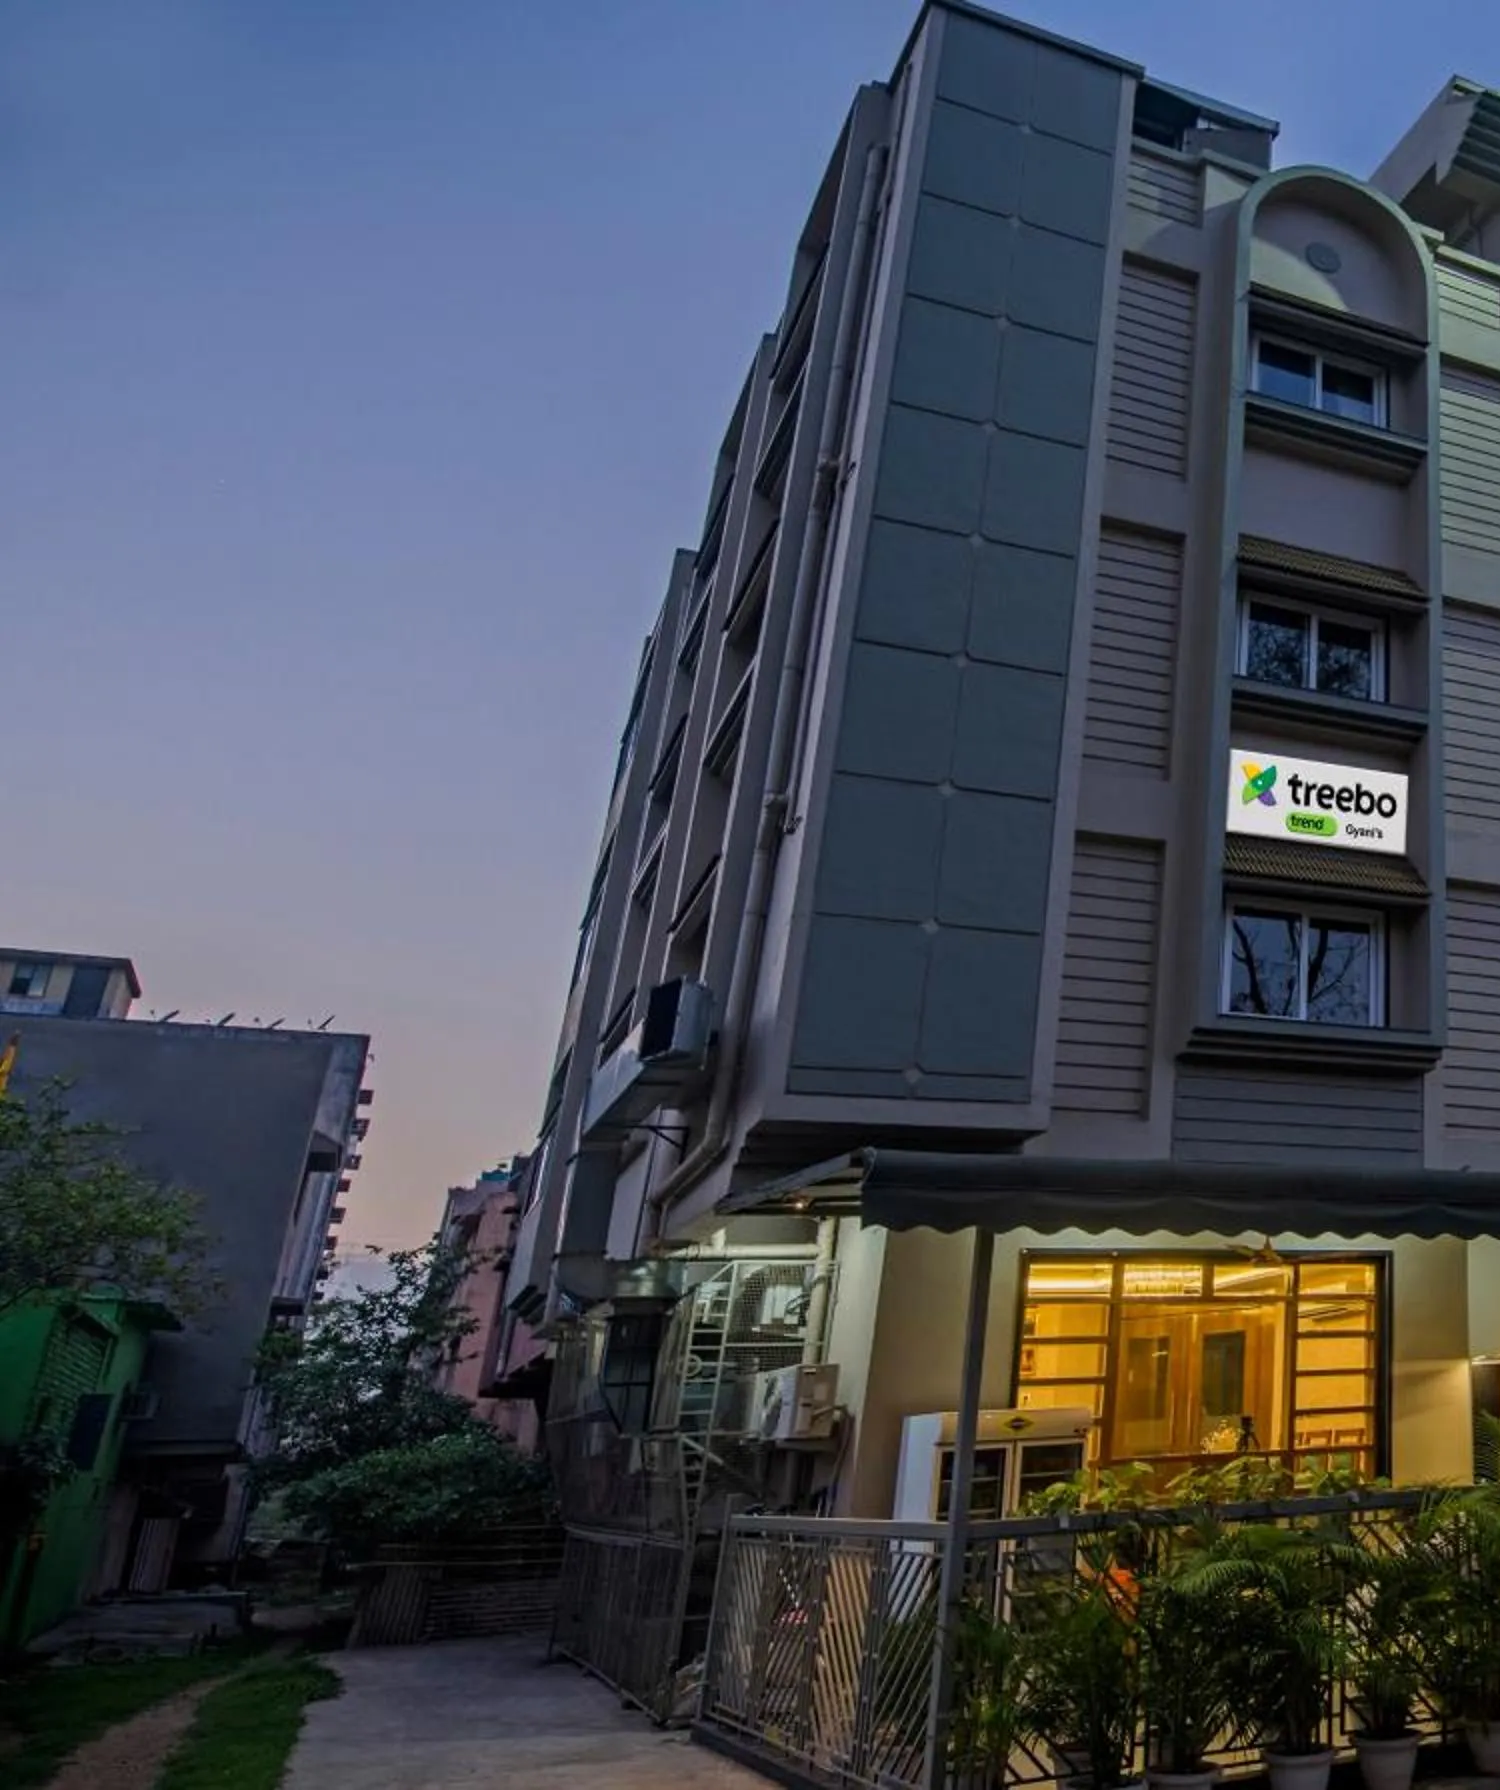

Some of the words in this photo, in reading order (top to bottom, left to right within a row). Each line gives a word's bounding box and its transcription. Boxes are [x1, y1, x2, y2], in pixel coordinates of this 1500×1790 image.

[1287, 774, 1397, 818] treebo
[1291, 815, 1325, 830] trend
[1345, 824, 1384, 839] Gyani's
